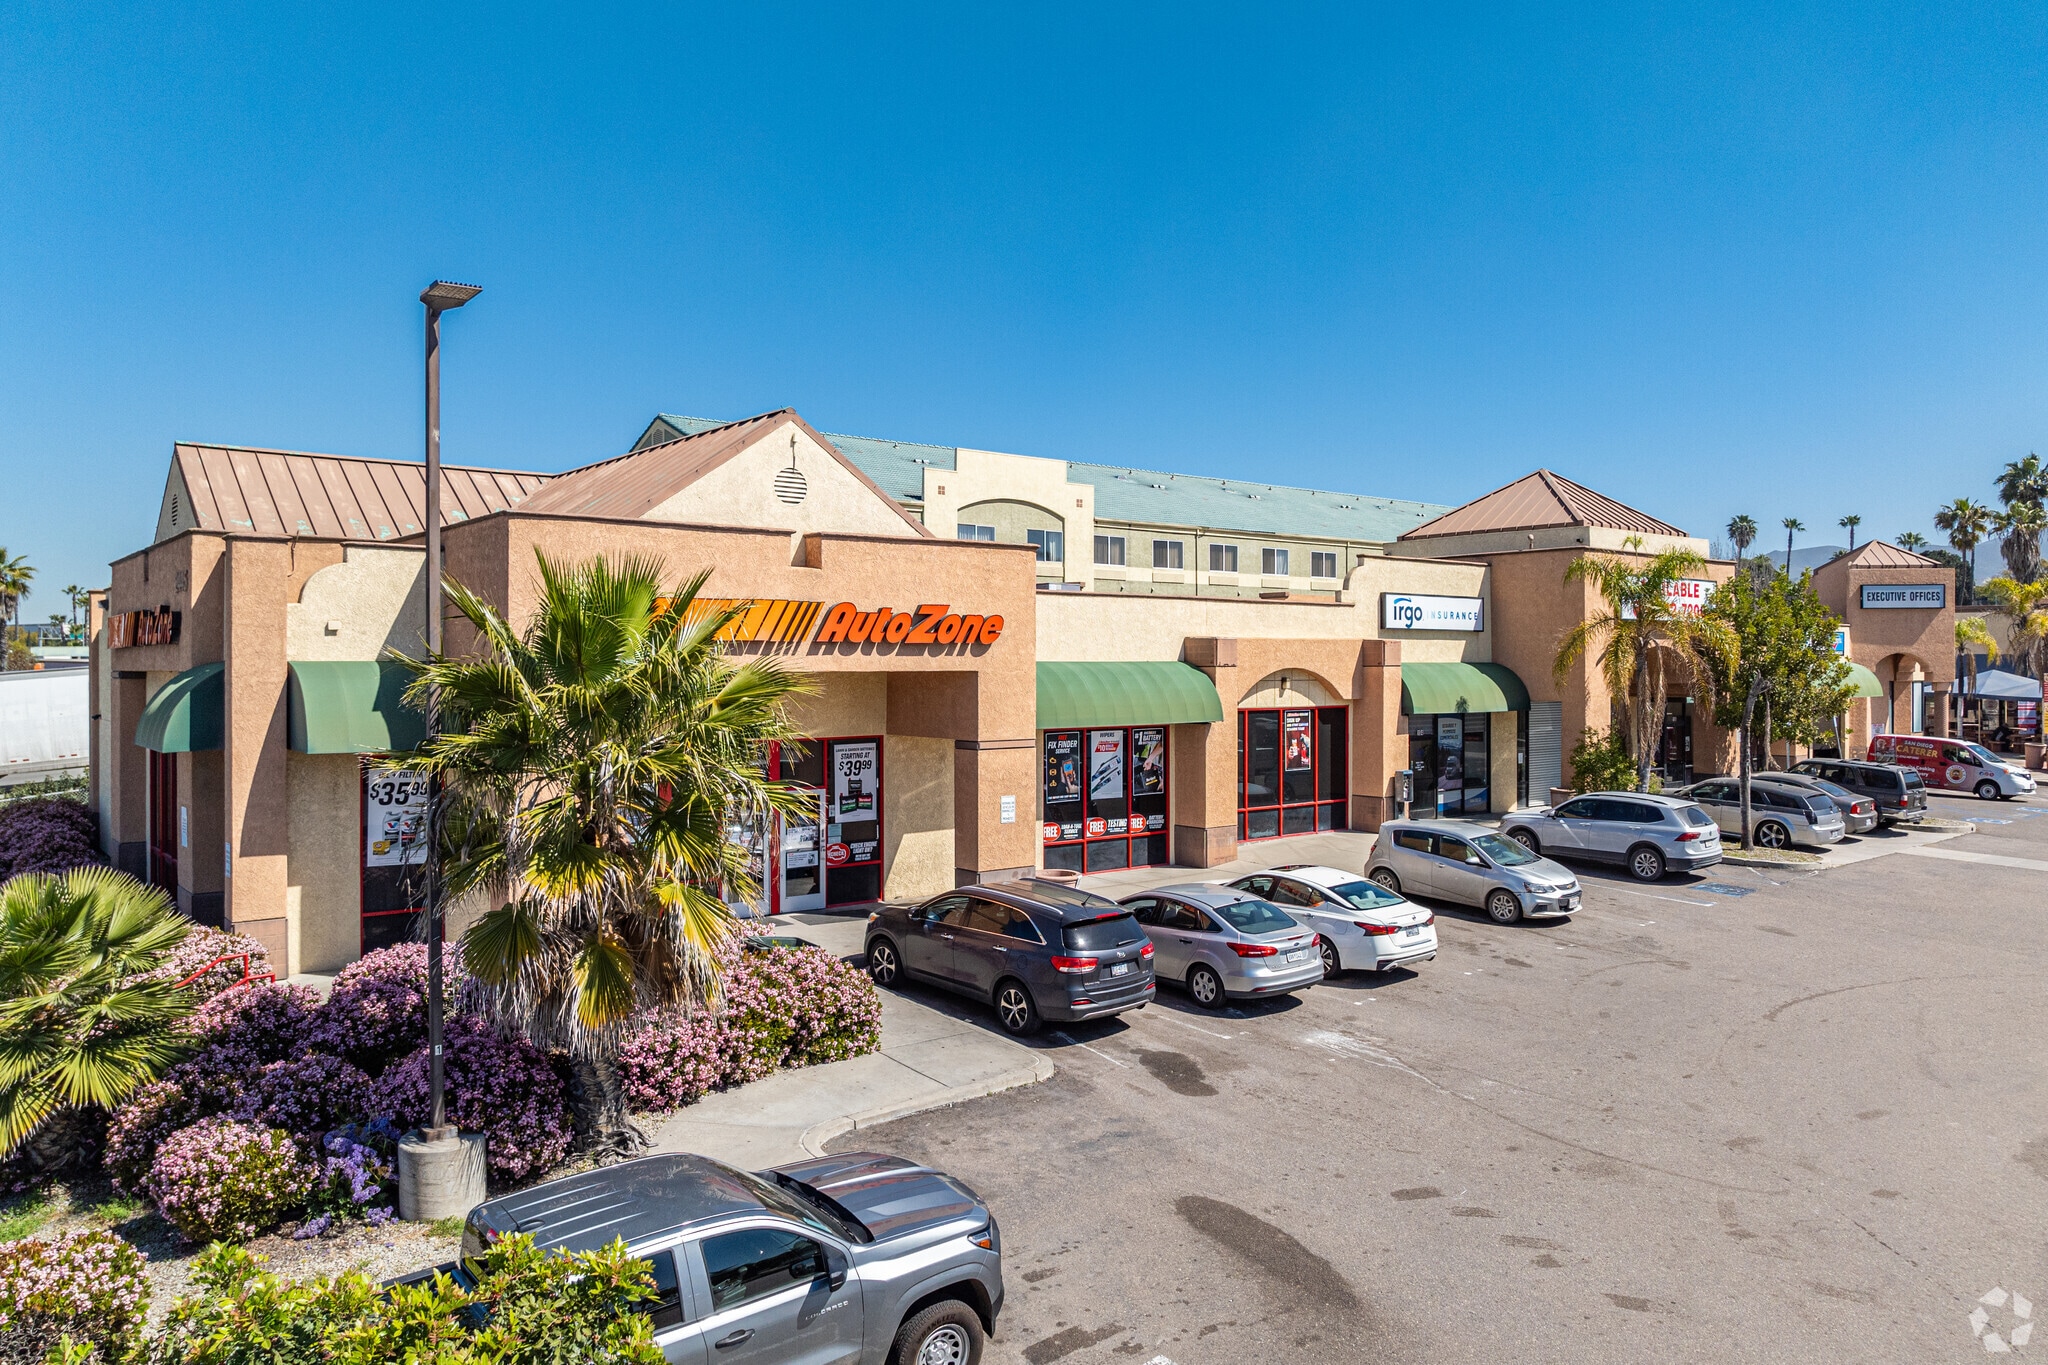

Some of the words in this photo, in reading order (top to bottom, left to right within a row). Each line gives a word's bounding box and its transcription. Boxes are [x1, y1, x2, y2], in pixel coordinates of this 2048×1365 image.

[1867, 591, 1906, 601] EXECUTIVE
[1909, 591, 1940, 601] OFFICES
[1393, 597, 1423, 628] irgo
[1426, 610, 1479, 621] INSURANCE
[814, 601, 1005, 645] AutoZone
[1048, 741, 1057, 749] FIX
[1058, 740, 1078, 748] FINDER
[1916, 741, 1934, 749] DIEGO
[840, 752, 863, 760] STARTING
[1896, 745, 1939, 758] CATERER
[1090, 821, 1104, 832] FREE
[1108, 819, 1127, 828] TESTING
[1131, 818, 1143, 829] FREE
[1044, 825, 1057, 837] FREE
[805, 1300, 849, 1320] COLORADO
